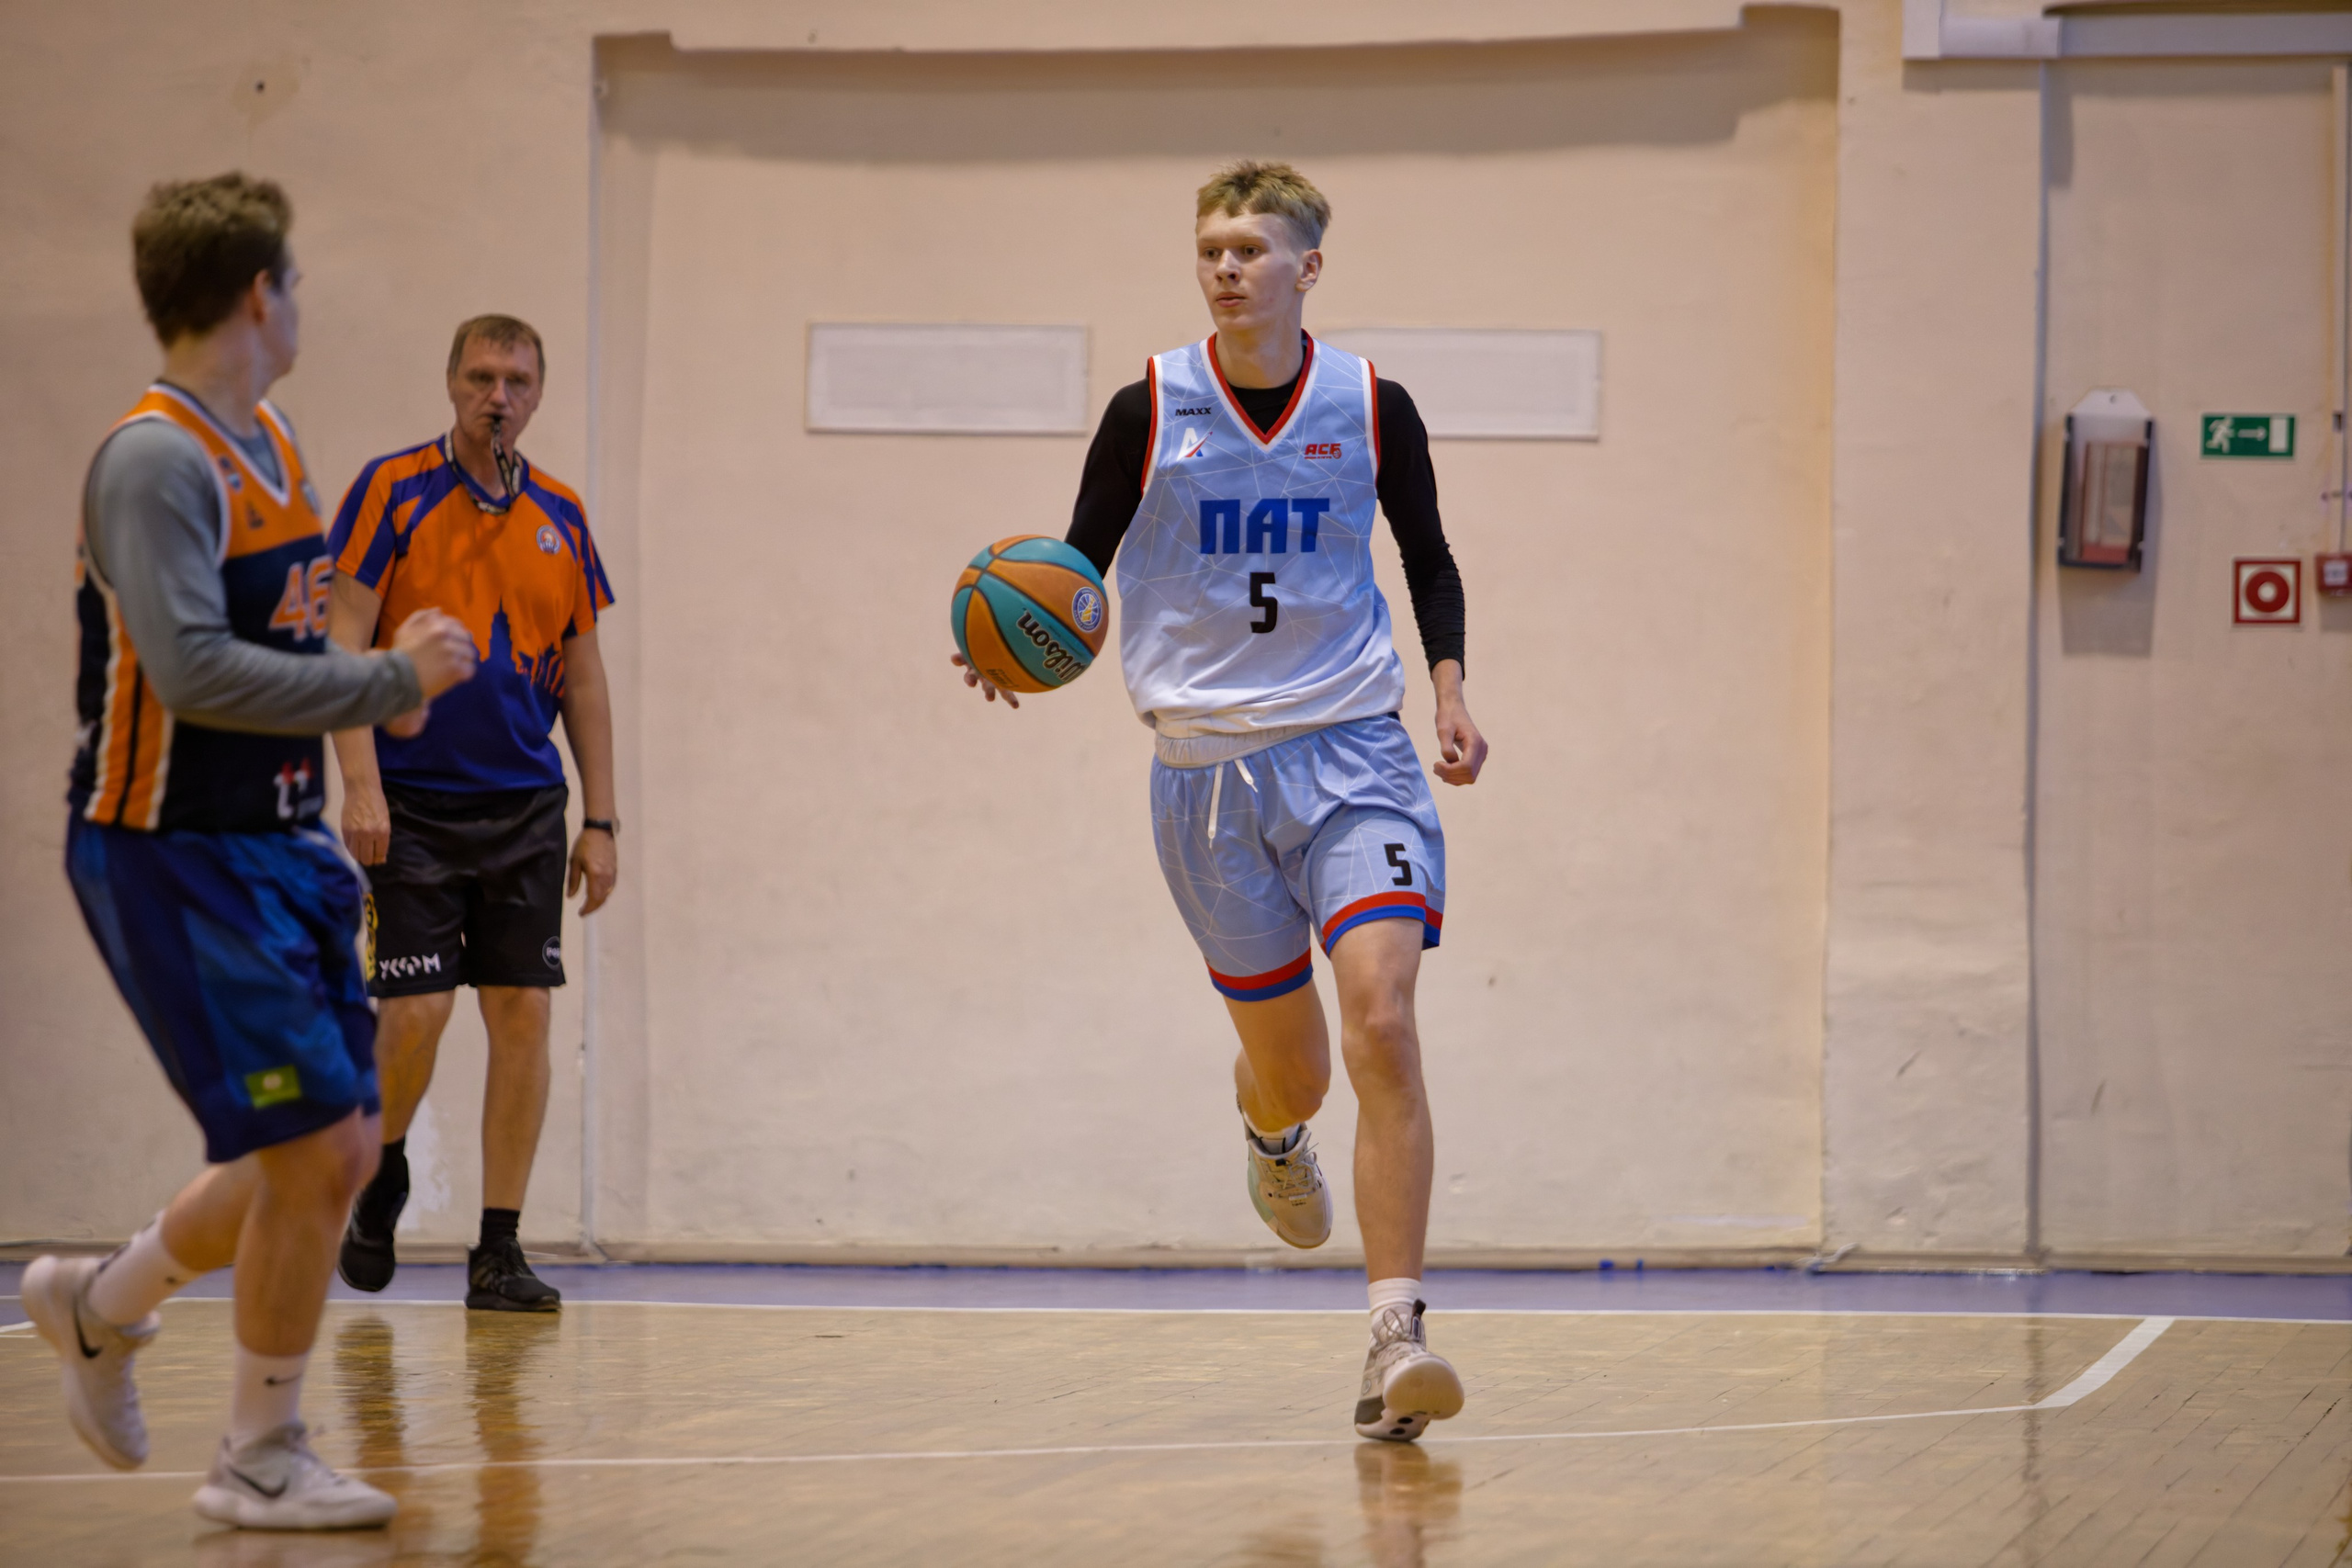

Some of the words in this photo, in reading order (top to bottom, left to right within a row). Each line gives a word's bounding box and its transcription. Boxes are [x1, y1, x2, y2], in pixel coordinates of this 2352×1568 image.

[1174, 407, 1212, 417] MAXX
[1199, 498, 1330, 555] ПАТ
[267, 554, 333, 642] 46
[1250, 571, 1279, 634] 5
[1016, 609, 1088, 682] Wilson
[1384, 842, 1413, 886] 5
